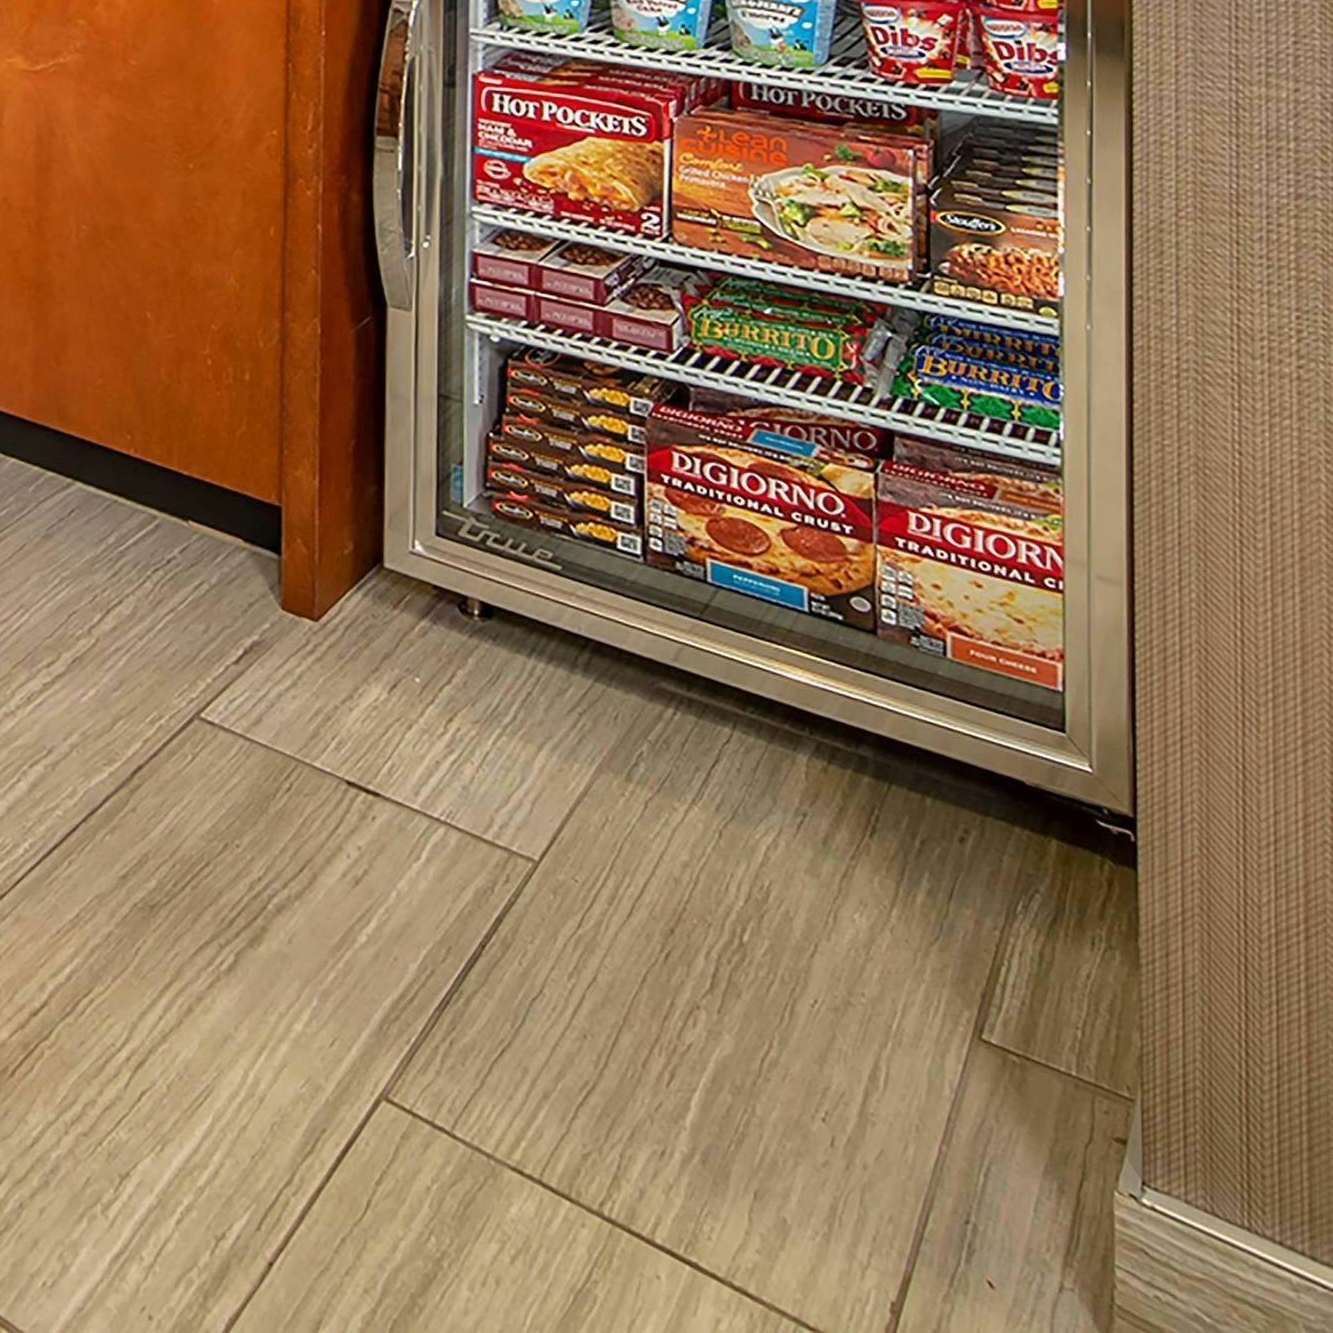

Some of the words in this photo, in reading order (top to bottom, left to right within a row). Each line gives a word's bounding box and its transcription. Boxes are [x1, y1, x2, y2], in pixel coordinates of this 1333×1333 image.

[871, 25, 938, 51] Dibs
[992, 40, 1059, 62] Dibs
[491, 93, 539, 119] HOT
[541, 101, 648, 137] POCKETS
[751, 82, 804, 107] HOT
[804, 92, 908, 118] POCKETS
[641, 212, 660, 231] 2
[699, 318, 835, 361] BURRITO
[661, 474, 784, 518] TRADITIONAL
[790, 511, 854, 535] CRUST
[671, 451, 845, 516] DIGIORNO
[895, 537, 1036, 584] TRADITIONAL
[907, 510, 1063, 571] DIGIORN
